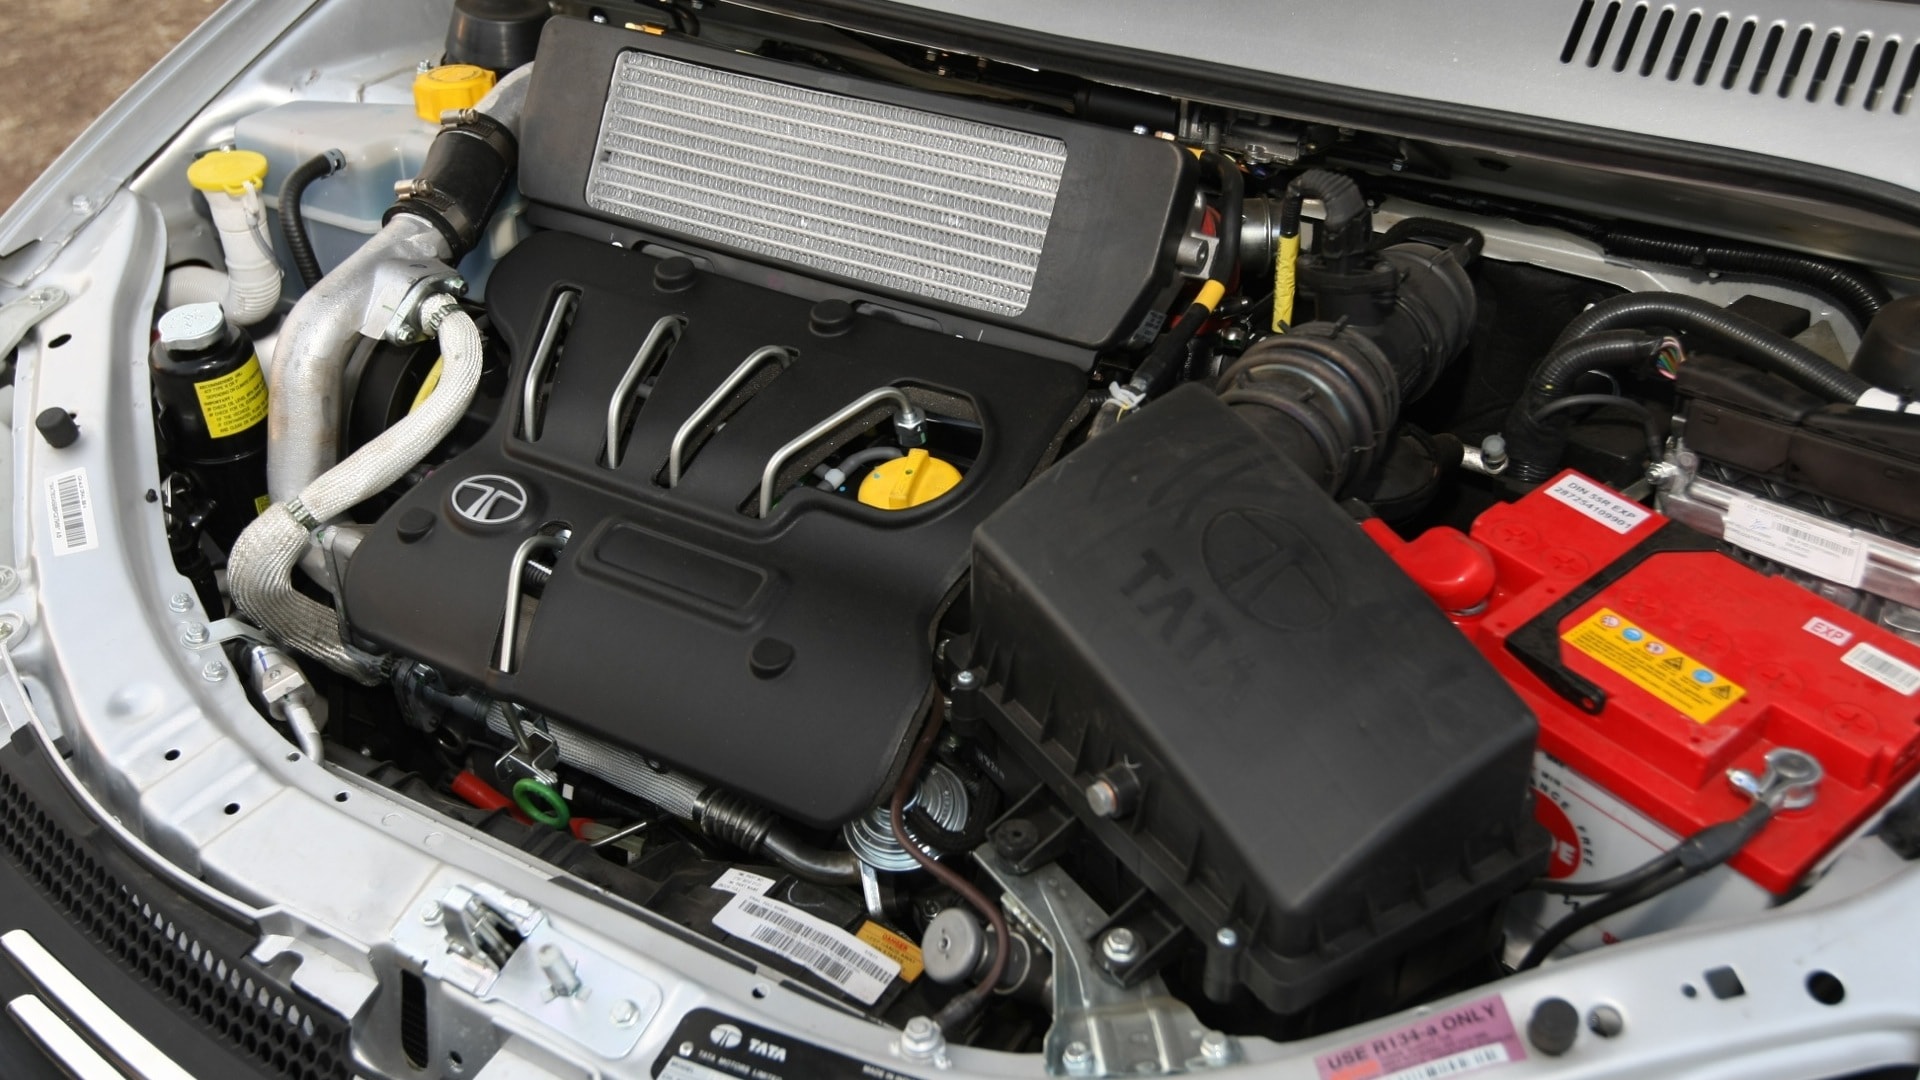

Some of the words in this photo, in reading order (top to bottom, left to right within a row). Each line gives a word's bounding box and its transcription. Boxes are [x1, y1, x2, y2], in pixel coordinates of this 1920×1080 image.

[1567, 482, 1589, 495] DIN
[1590, 493, 1611, 507] 55R
[1611, 505, 1637, 519] EXP
[1811, 621, 1845, 639] EXP
[1576, 824, 1594, 867] FREE
[881, 932, 908, 952] DANGER
[748, 1037, 787, 1063] TATA
[1327, 1046, 1369, 1071] USE
[1371, 1025, 1439, 1056] R134-a
[1441, 1002, 1497, 1032] ONLY
[699, 1049, 716, 1063] TATA
[718, 1056, 751, 1076] MOTORS
